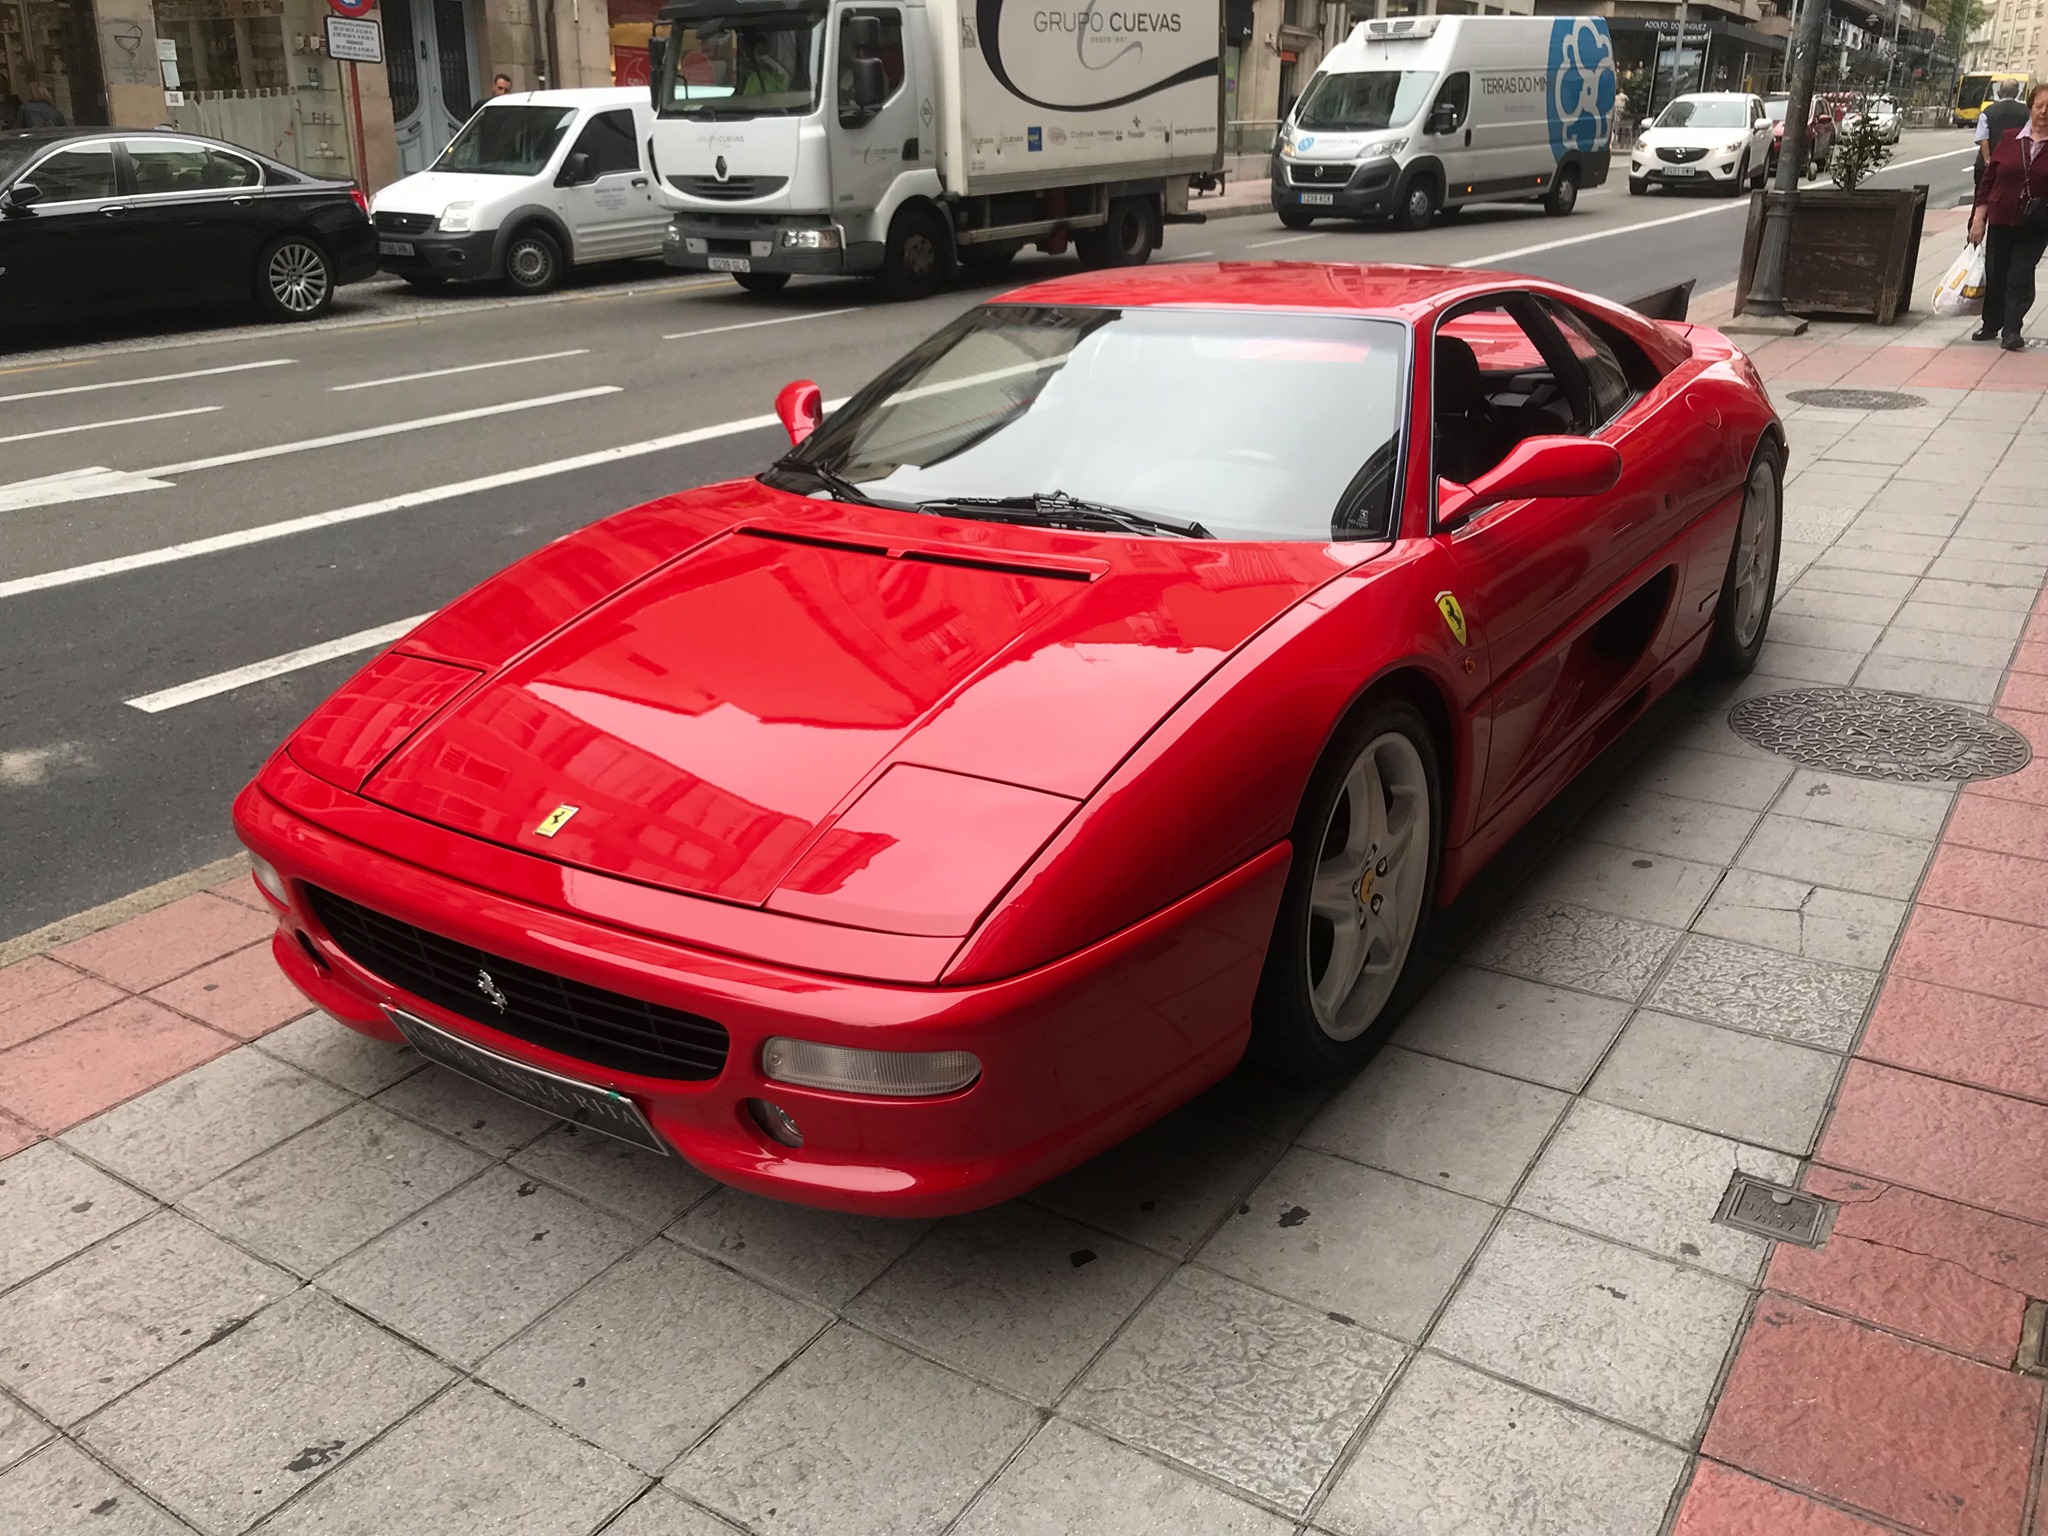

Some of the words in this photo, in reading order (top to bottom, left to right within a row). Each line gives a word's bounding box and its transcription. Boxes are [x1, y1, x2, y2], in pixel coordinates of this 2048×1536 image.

[1033, 11, 1103, 33] GRUPO
[1109, 12, 1181, 33] CUEVAS
[1644, 20, 1668, 30] ADOLFO
[1480, 76, 1517, 95] TERRAS
[1518, 76, 1532, 93] DO
[479, 1058, 570, 1104] SANTA
[572, 1092, 642, 1128] RITA
